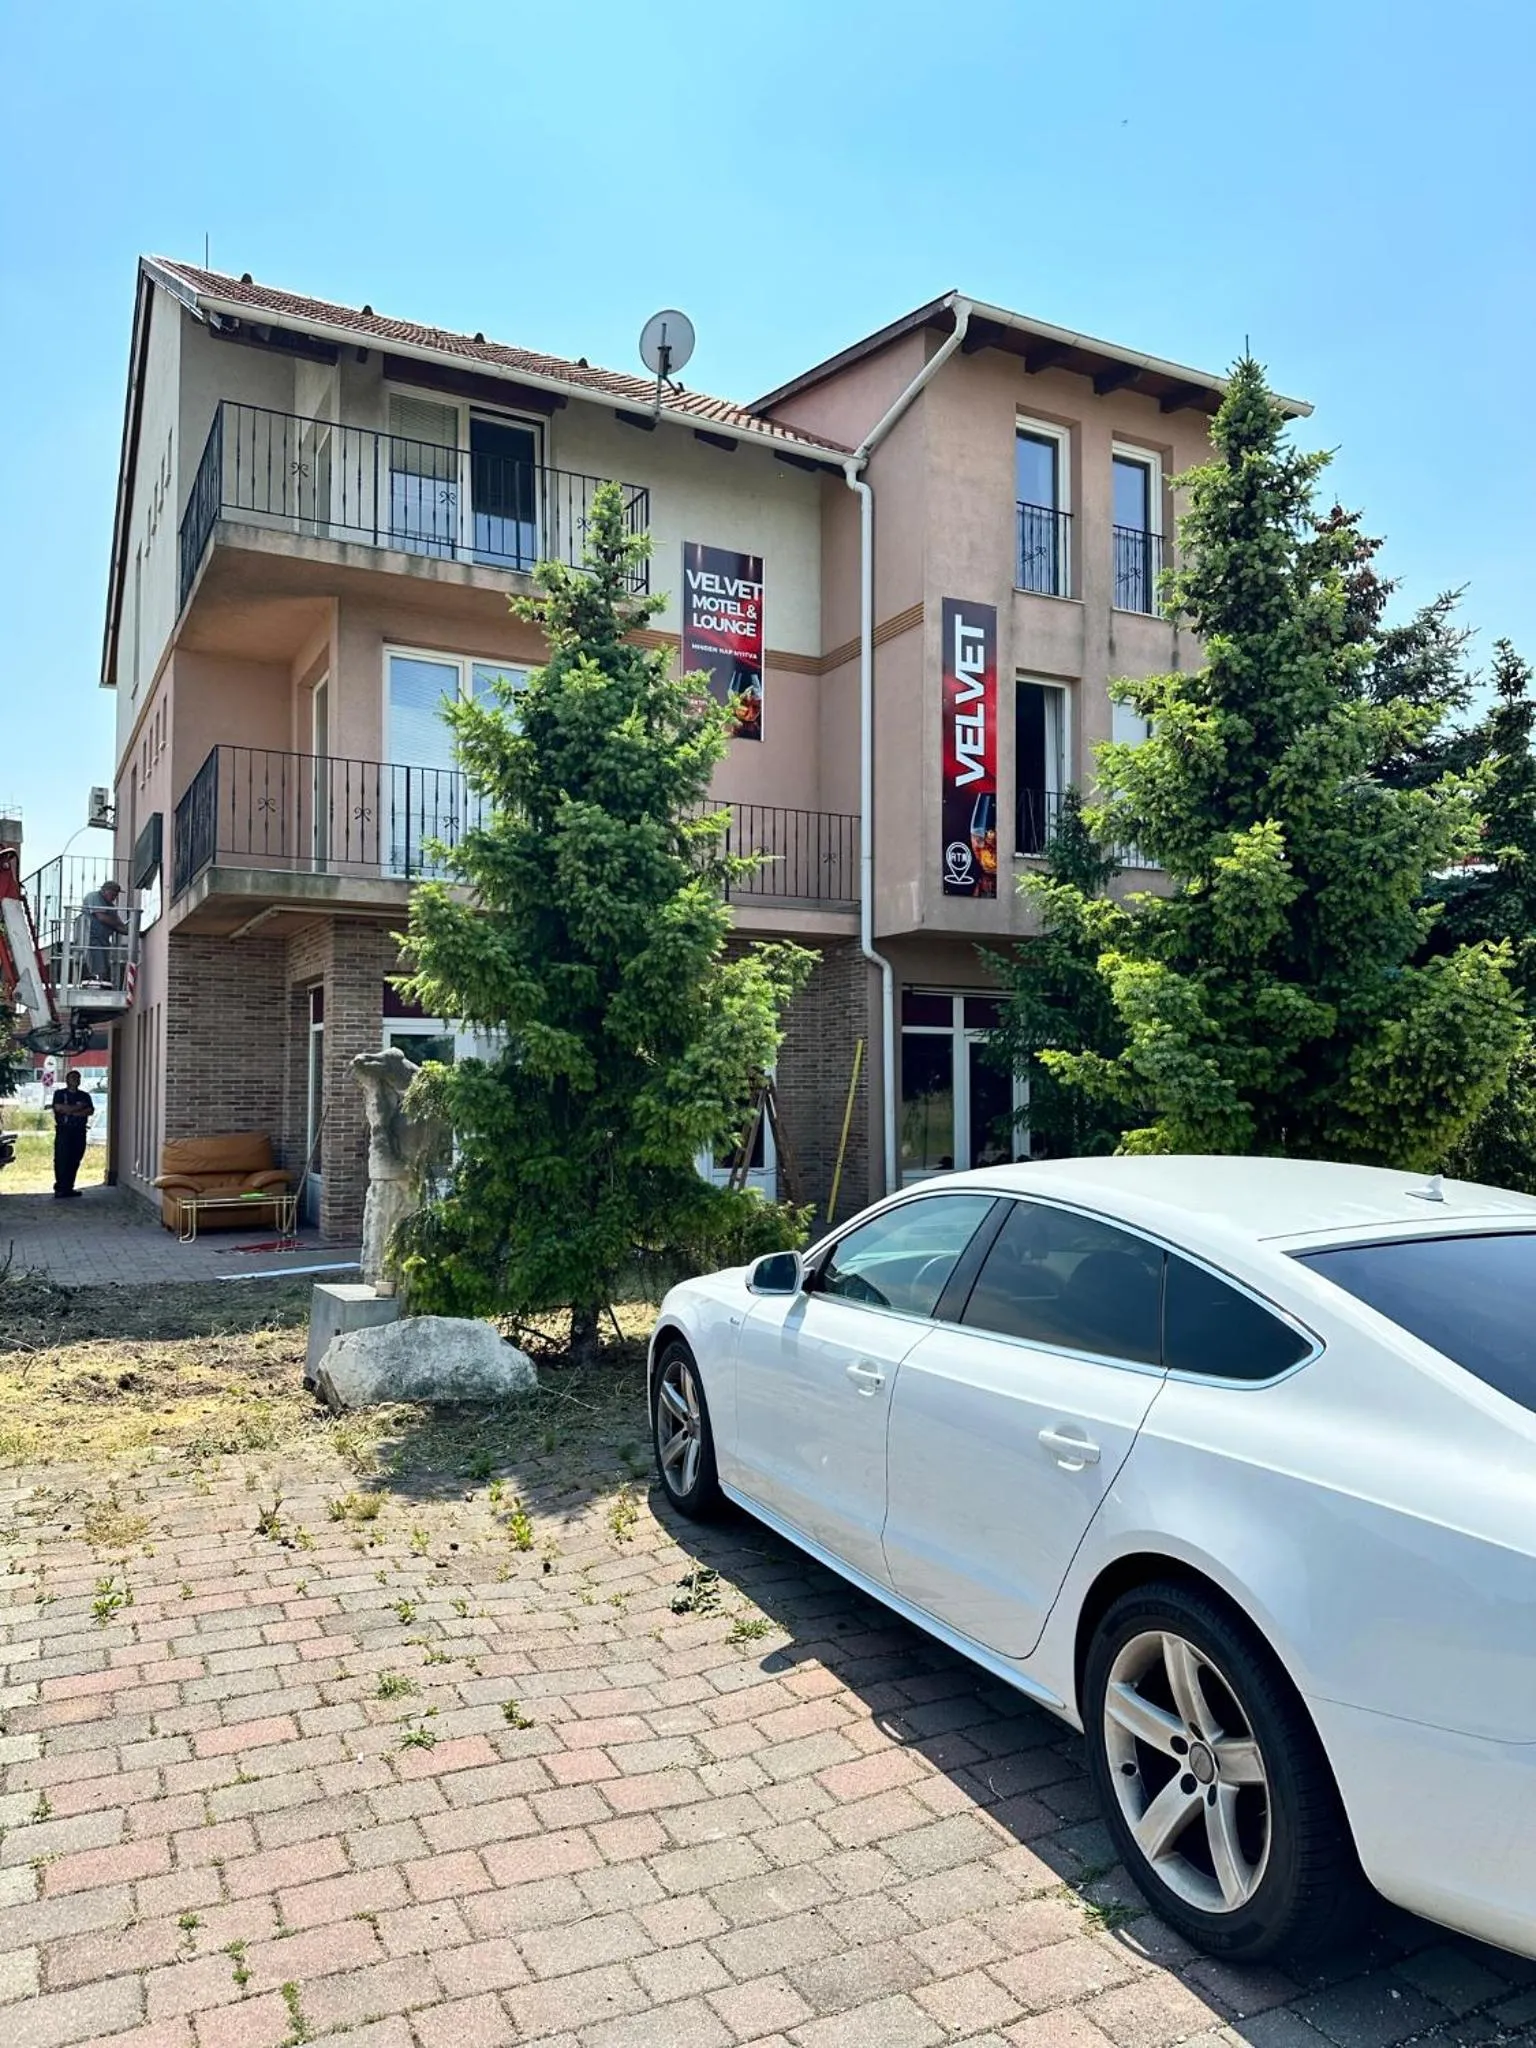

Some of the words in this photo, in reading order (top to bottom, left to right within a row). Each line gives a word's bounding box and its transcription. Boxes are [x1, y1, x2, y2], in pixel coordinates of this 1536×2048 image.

[686, 569, 763, 601] VELVET
[692, 594, 745, 617] MOTEL
[746, 604, 757, 620] &
[692, 612, 757, 637] LOUNGE
[691, 643, 718, 653] MINDEN
[734, 650, 758, 659] NYITVA
[955, 614, 985, 787] VELVET
